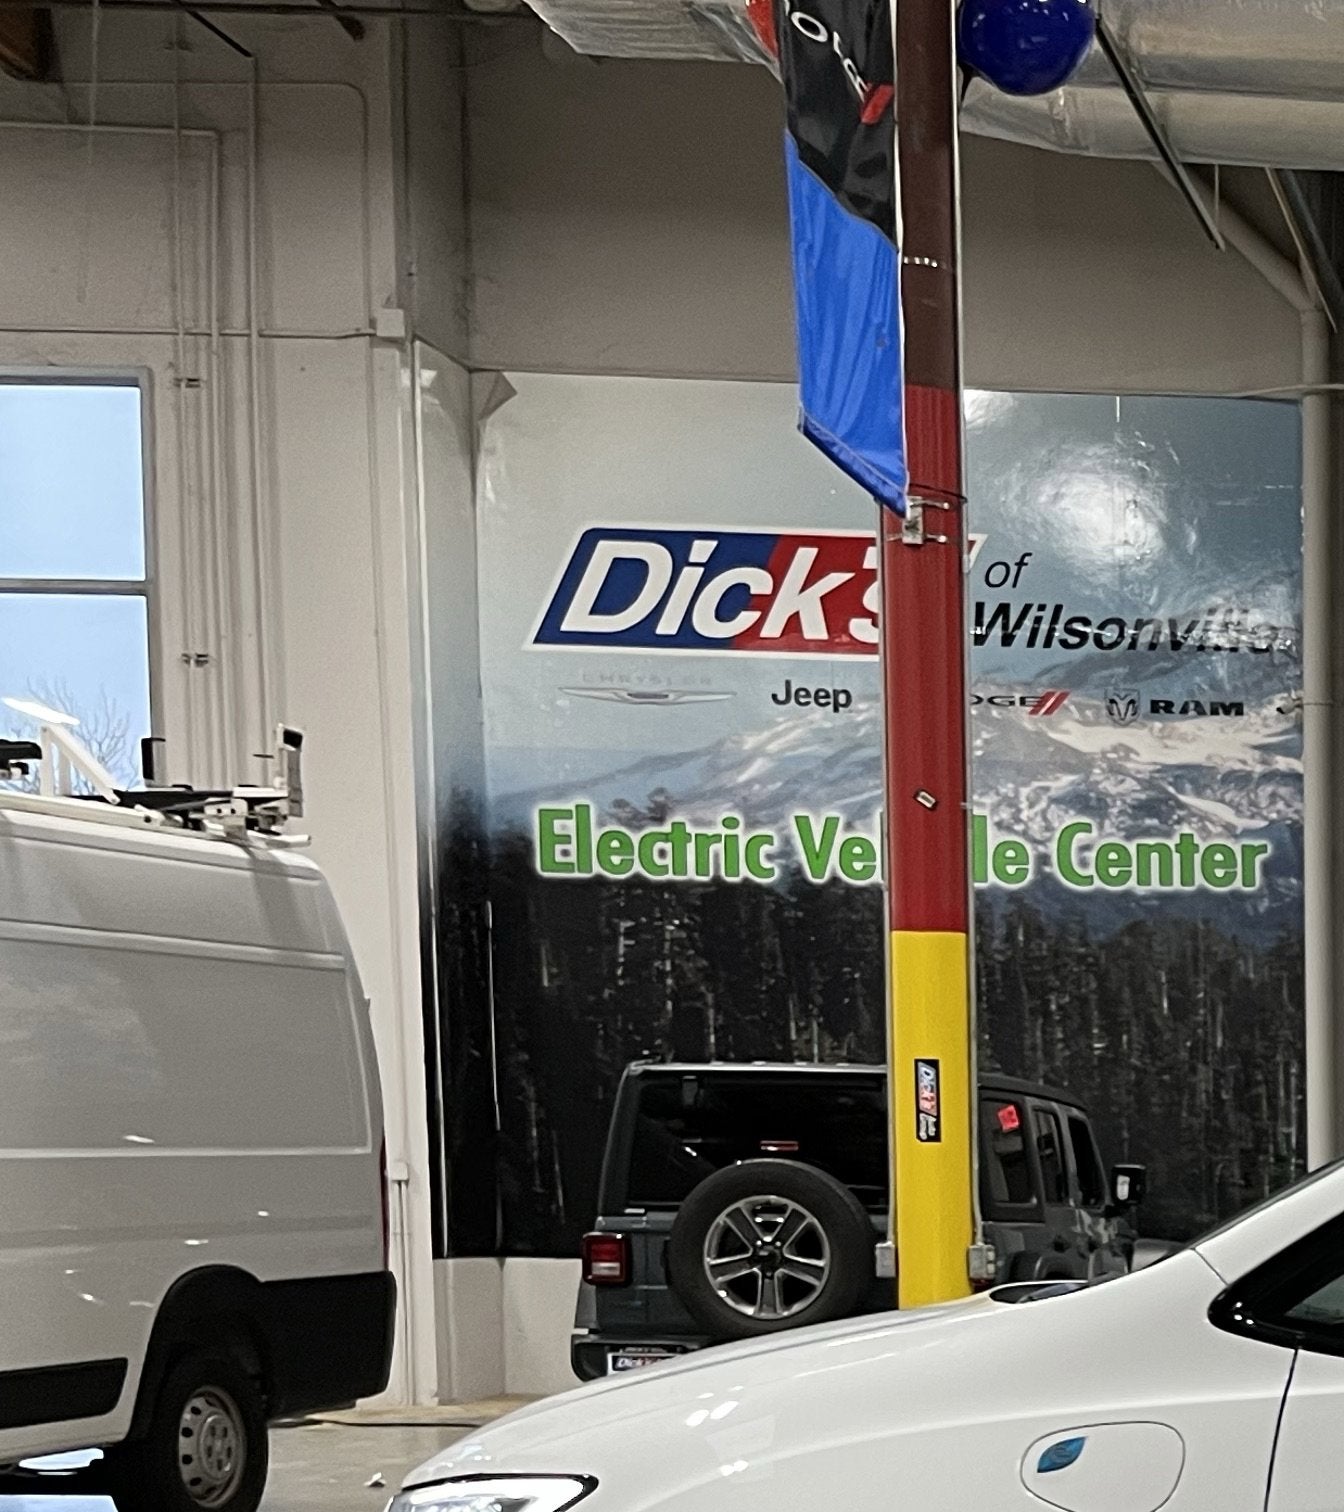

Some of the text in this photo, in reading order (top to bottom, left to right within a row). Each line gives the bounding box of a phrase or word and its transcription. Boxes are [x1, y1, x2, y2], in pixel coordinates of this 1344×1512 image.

[984, 552, 1033, 589] of
[771, 679, 853, 713] Jeep
[1150, 699, 1245, 717] RAM
[538, 803, 1268, 888] Electric Vele Center
